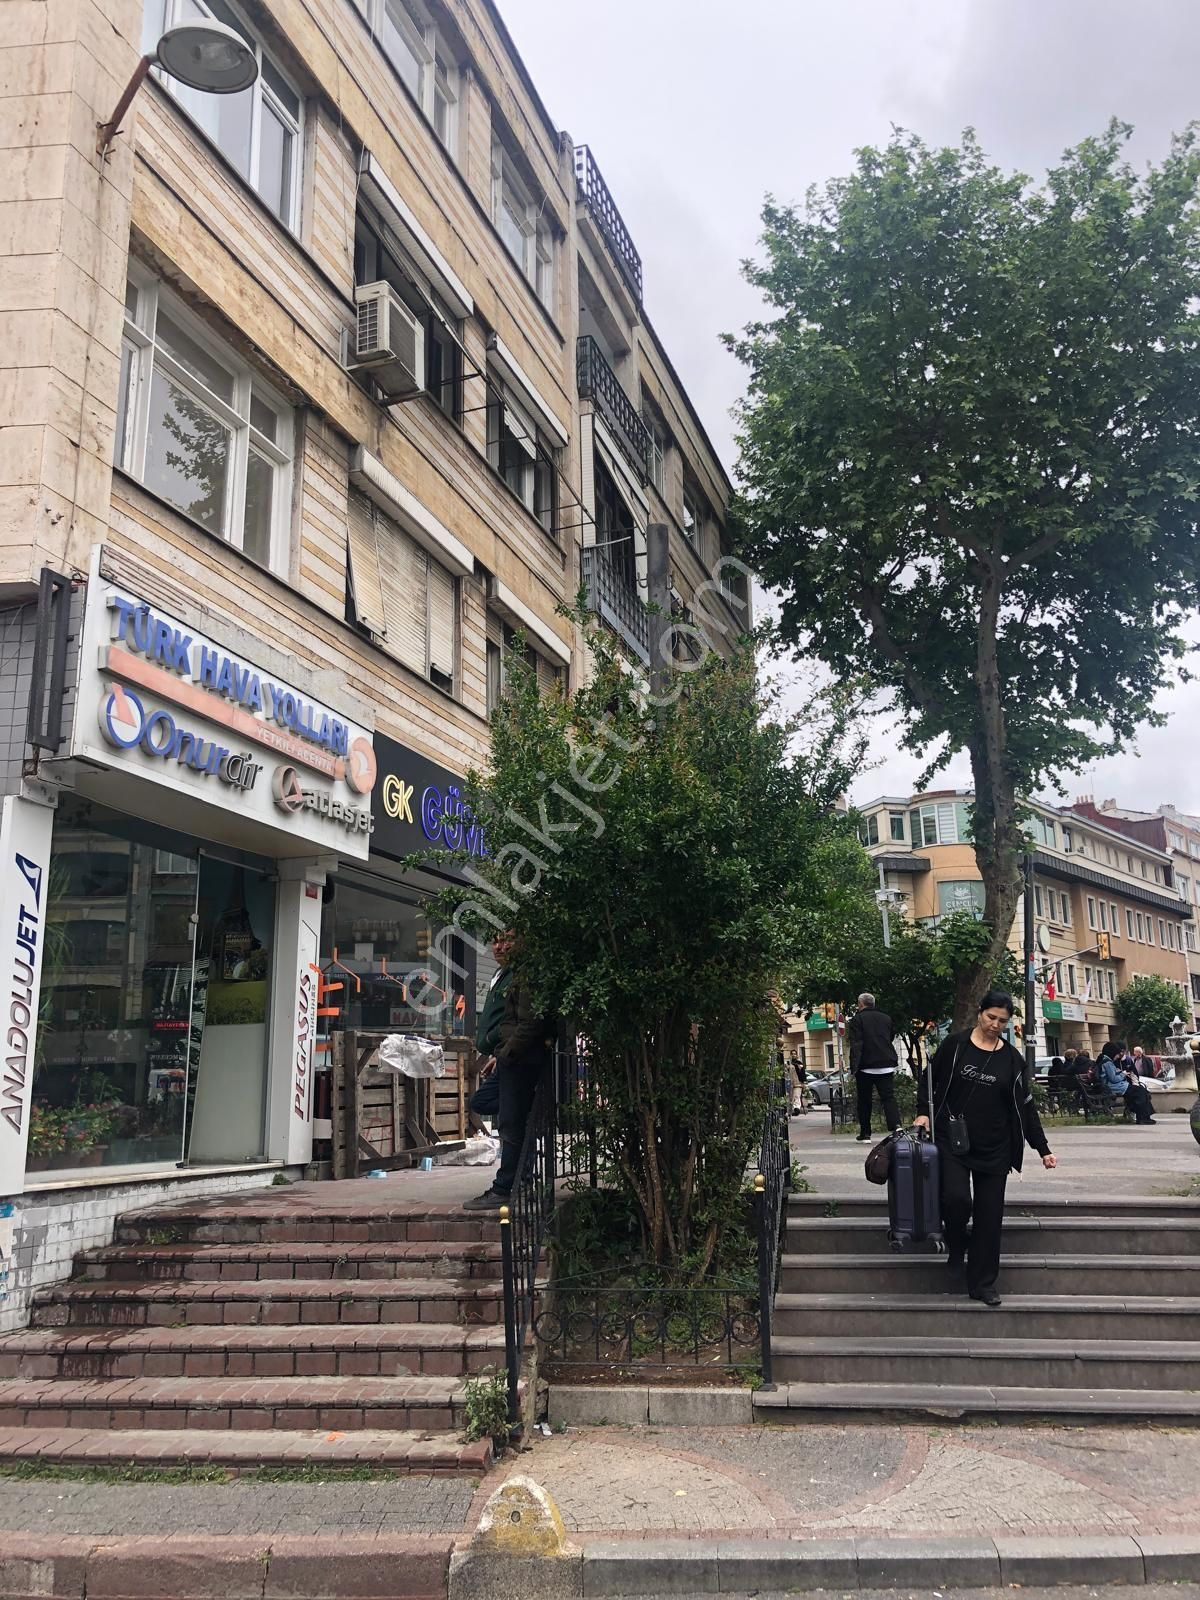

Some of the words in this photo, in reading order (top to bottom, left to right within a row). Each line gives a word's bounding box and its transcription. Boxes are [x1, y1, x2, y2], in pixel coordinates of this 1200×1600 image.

[110, 595, 194, 676] TÜRK
[198, 645, 263, 713] HAVA
[383, 774, 414, 824] GK
[0, 903, 39, 1136] ANADOLUJET
[295, 969, 312, 1120] PEGASUS
